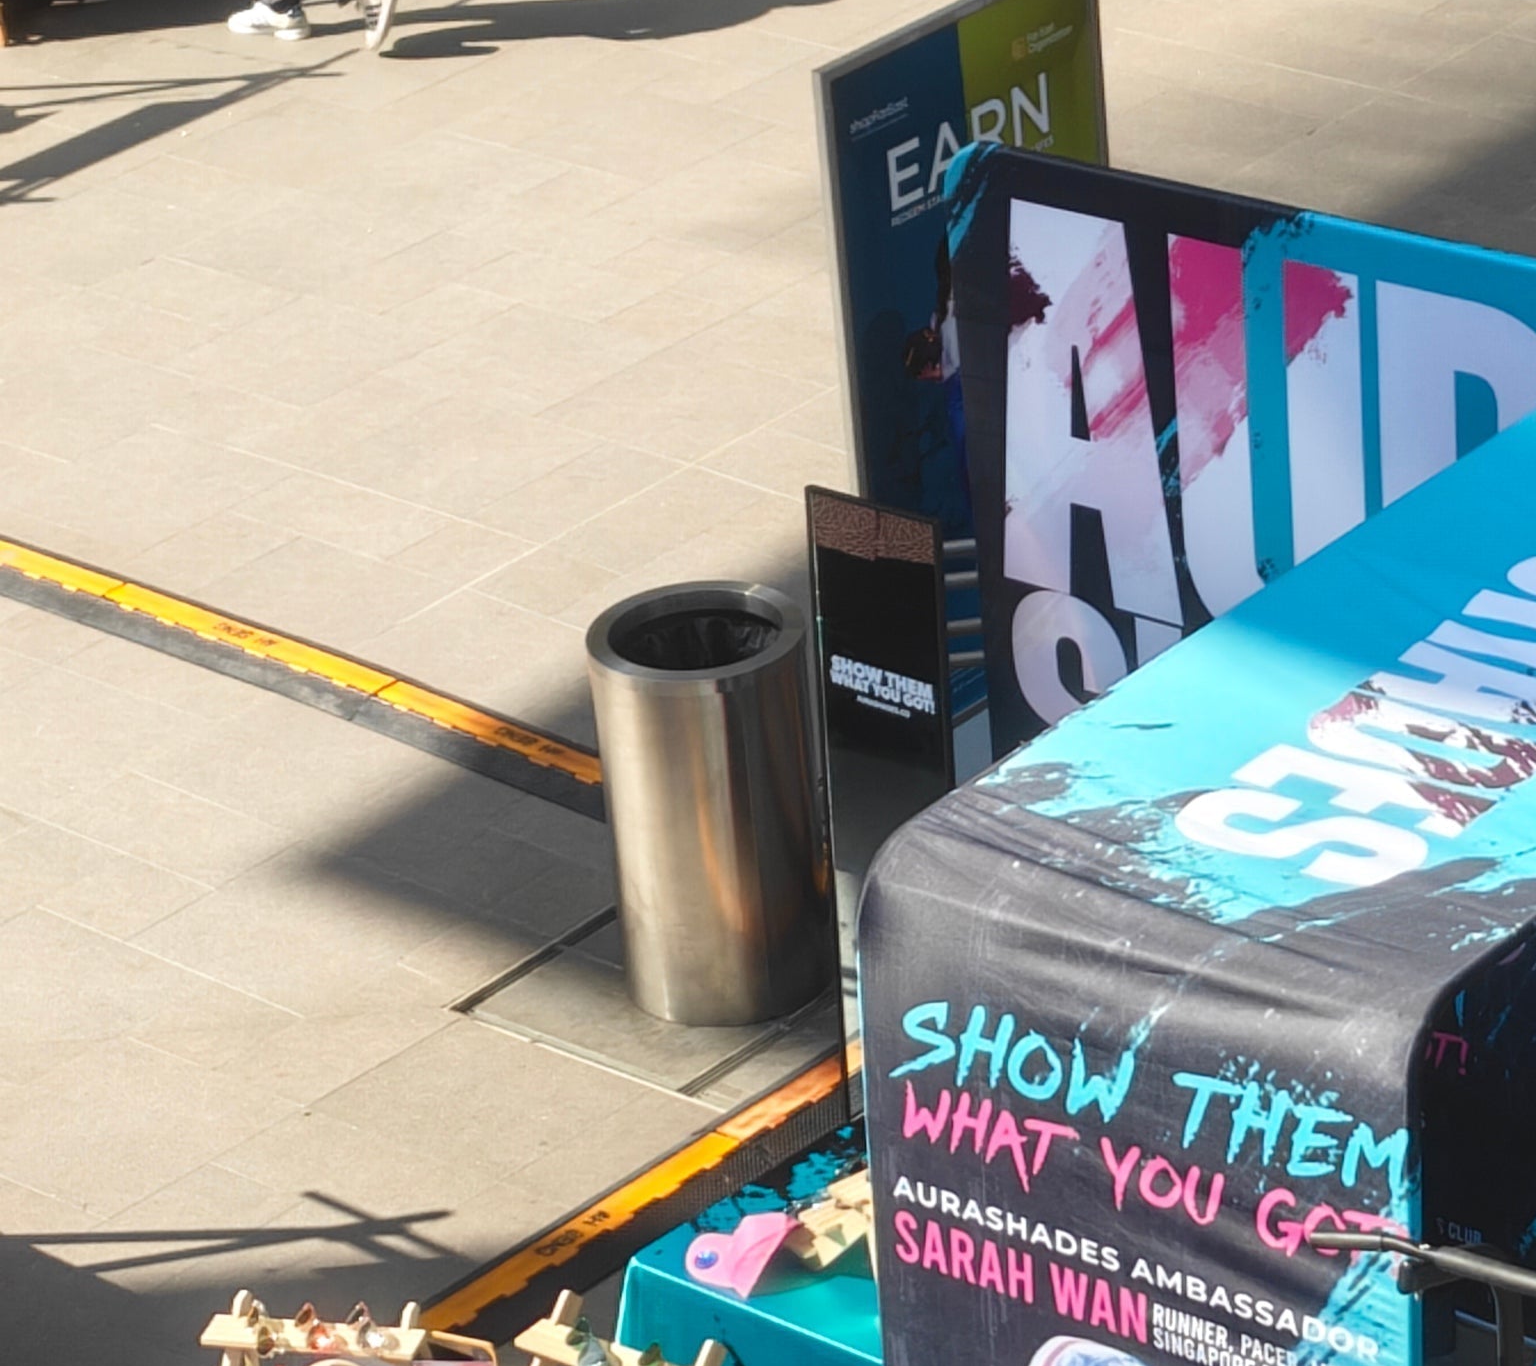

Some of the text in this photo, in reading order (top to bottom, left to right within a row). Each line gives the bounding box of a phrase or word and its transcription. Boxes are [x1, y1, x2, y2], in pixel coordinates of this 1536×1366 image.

[886, 72, 1051, 213] EARN
[830, 654, 934, 700] SHOW THEM
[830, 668, 936, 716] WHAT YOU GOT!
[889, 1000, 1412, 1203] SHOW THEM
[900, 1079, 1081, 1195] WHAT
[1099, 1137, 1225, 1227] YOU
[893, 1176, 1380, 1362] AURASHADES AMBASSADOR
[894, 1211, 1149, 1345] SARAH WAN
[1152, 1302, 1234, 1353] RUNNER,
